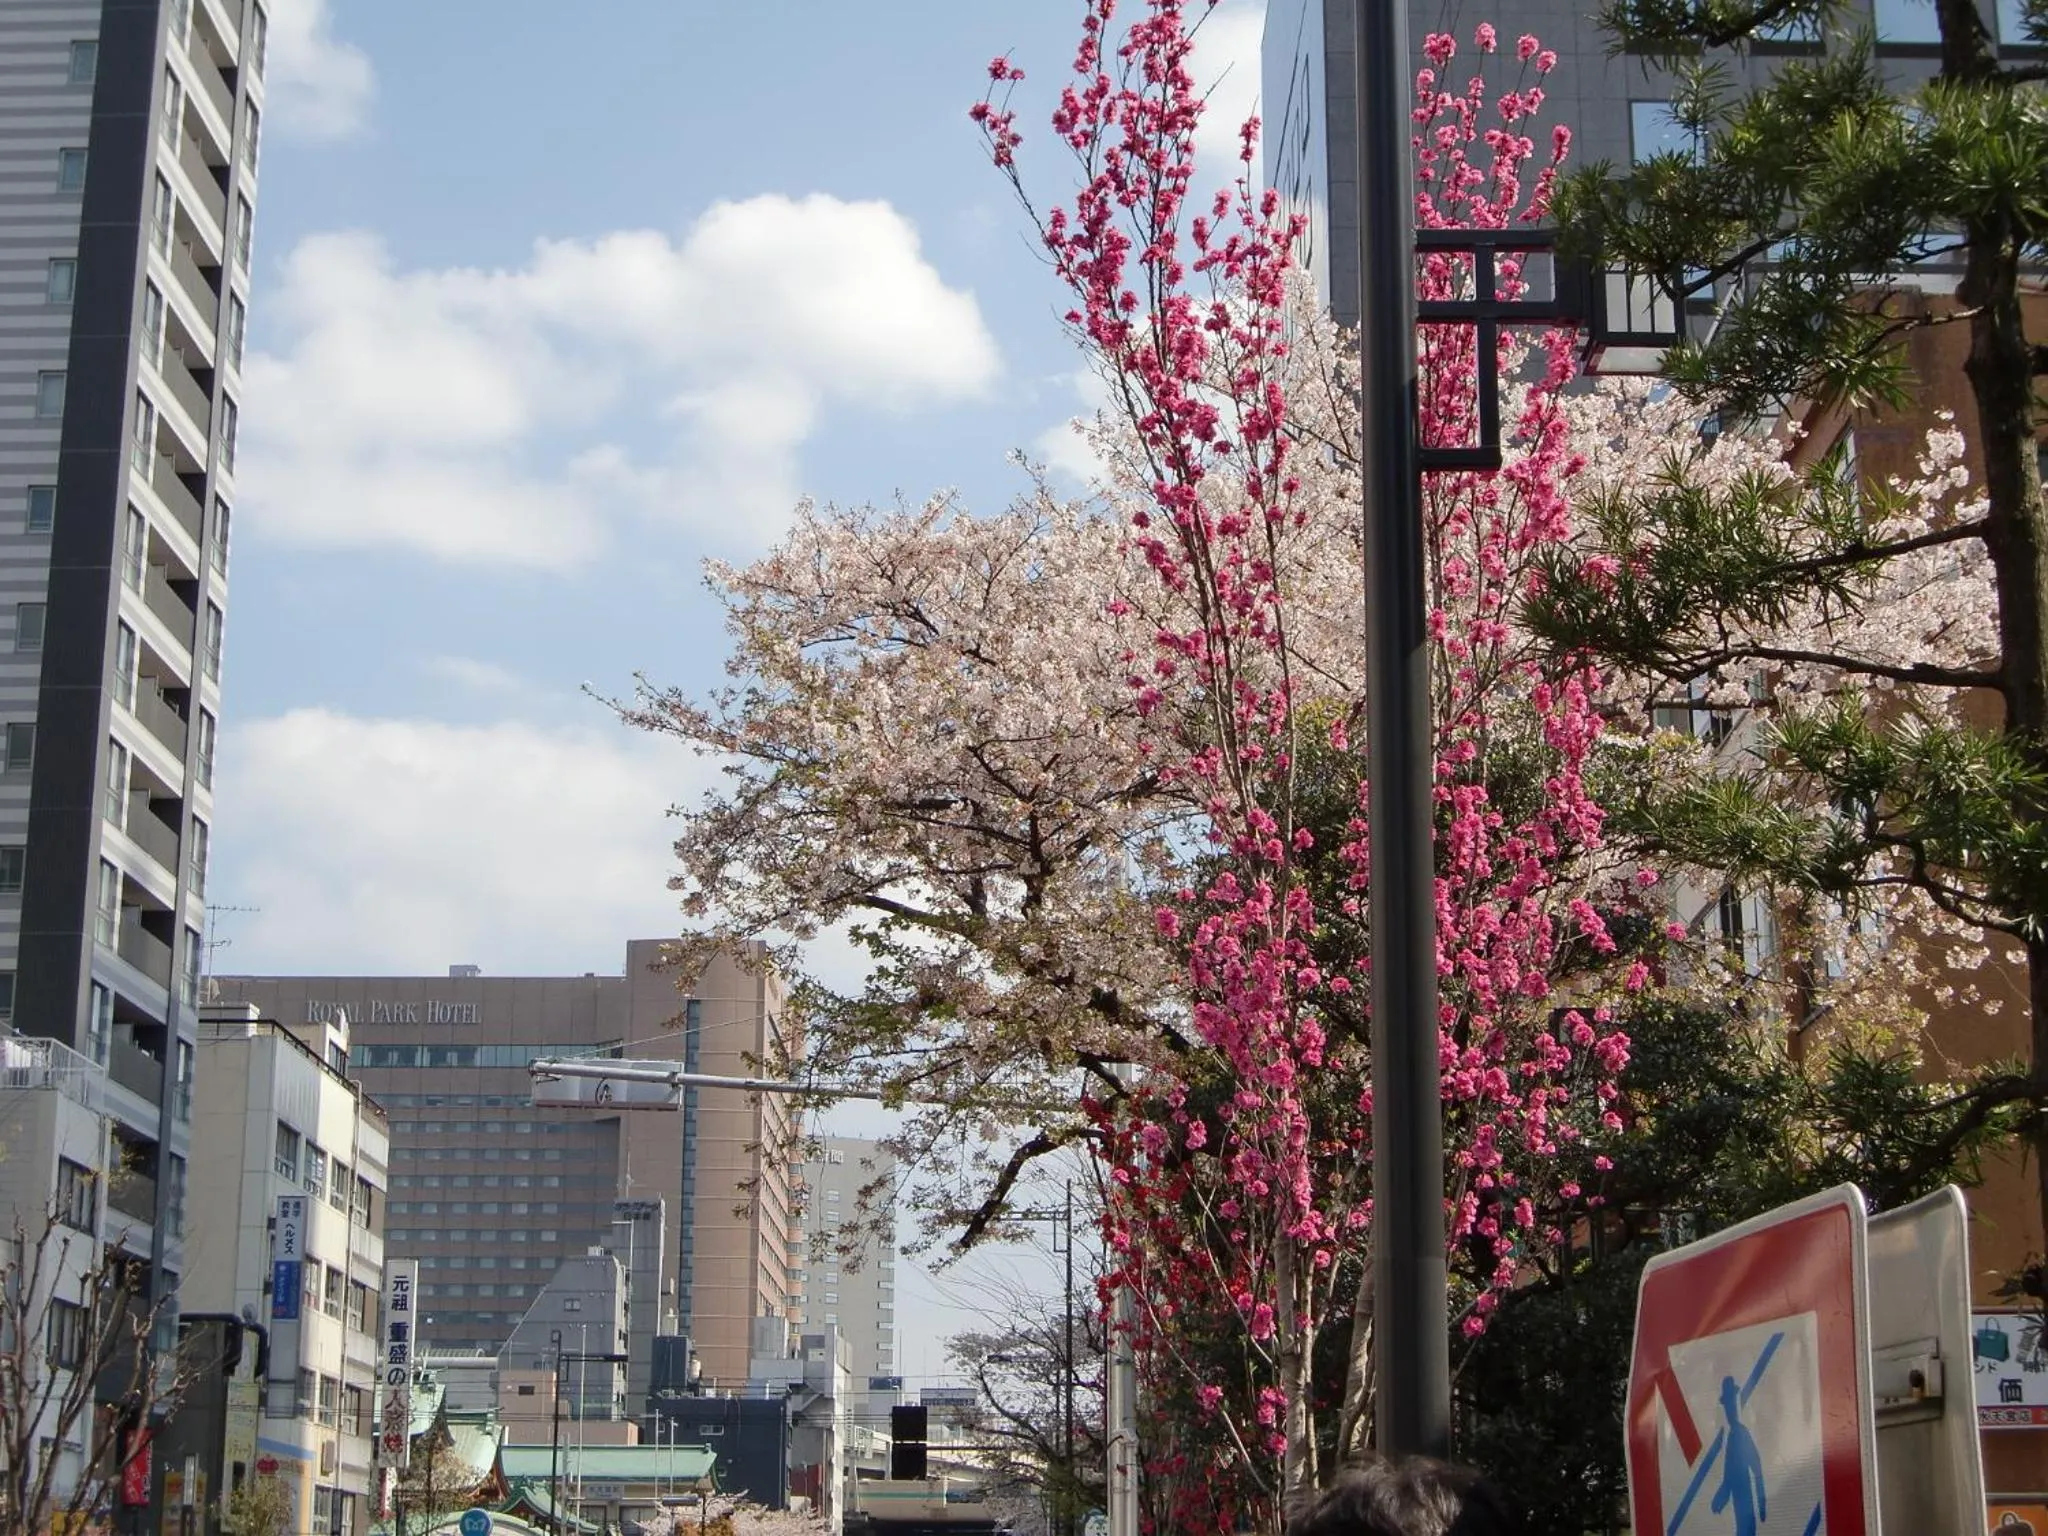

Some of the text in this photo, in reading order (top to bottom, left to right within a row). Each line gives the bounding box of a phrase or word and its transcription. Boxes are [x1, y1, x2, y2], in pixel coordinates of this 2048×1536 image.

[371, 1000, 419, 1024] PARK
[427, 1000, 482, 1024] HOTEL
[284, 1223, 295, 1255] ヘルメス
[391, 1275, 409, 1311] 元祖
[1998, 1378, 2023, 1403] 価
